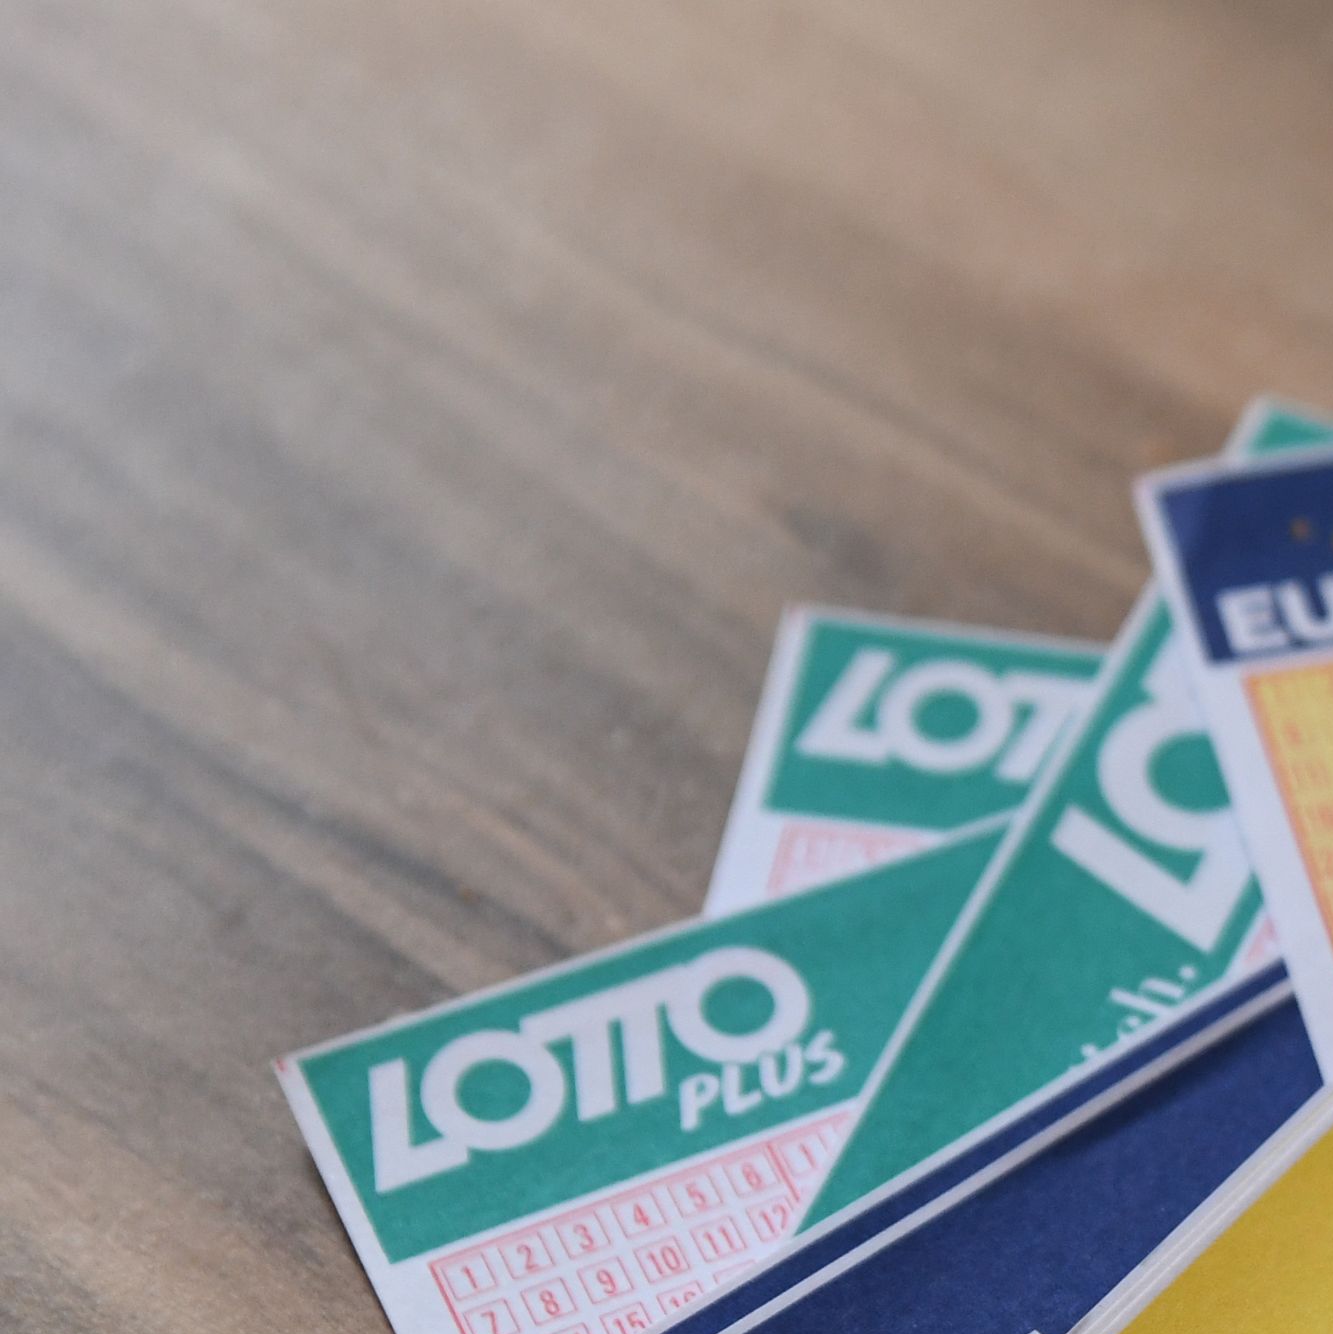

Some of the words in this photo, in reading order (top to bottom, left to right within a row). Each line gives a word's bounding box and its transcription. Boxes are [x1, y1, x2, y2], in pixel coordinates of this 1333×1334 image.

[367, 945, 812, 1193] LOTTO
[679, 1029, 846, 1133] PLUS
[462, 1265, 480, 1292] 1
[516, 1243, 541, 1274] 2
[574, 1223, 597, 1253] 3
[539, 1289, 562, 1318] 8
[647, 1246, 683, 1277] 10
